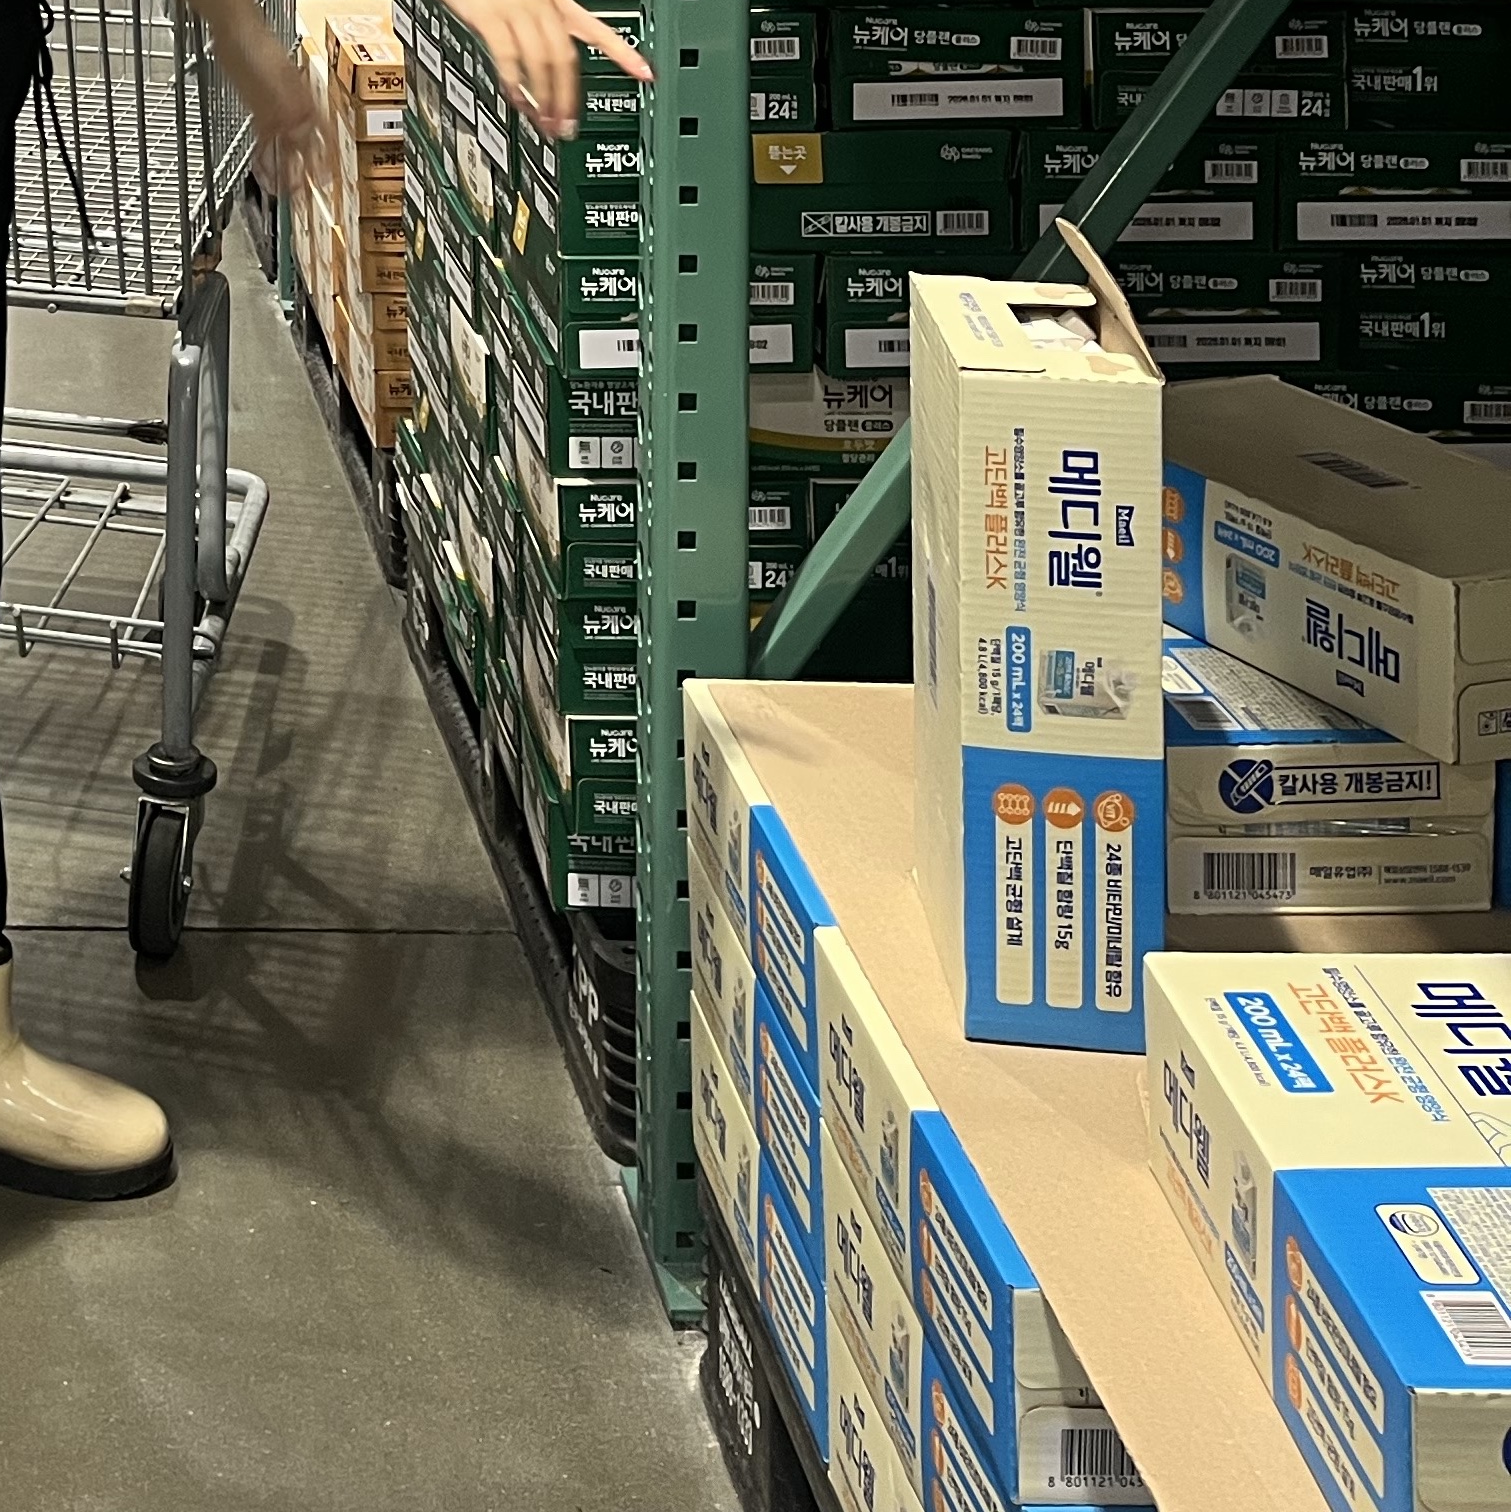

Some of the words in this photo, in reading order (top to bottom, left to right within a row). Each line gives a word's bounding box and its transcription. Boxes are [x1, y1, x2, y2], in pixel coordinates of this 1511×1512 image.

[853, 25, 909, 47] 뉴케어
[1354, 18, 1409, 38] 뉴케어
[1114, 31, 1171, 50] 뉴케어
[368, 76, 404, 90] 뉴케어
[769, 101, 790, 119] 24
[1301, 99, 1323, 117] 24
[596, 144, 630, 152] Nucare
[585, 152, 641, 173] 뉴케어
[1299, 151, 1355, 172] 뉴케어
[591, 267, 625, 276] Nucare
[858, 268, 891, 277] Nucare
[1360, 263, 1416, 283] 뉴케어
[580, 276, 636, 297] 뉴케어
[846, 278, 903, 298] 뉴케어
[823, 385, 893, 409] 뉴케어
[985, 445, 1008, 509] 고단백
[589, 494, 623, 502] Nucare
[579, 502, 635, 522] 뉴케어
[1048, 449, 1103, 589] 메디웰
[985, 513, 1008, 590] 플러스K
[765, 571, 787, 588] 24
[1011, 632, 1026, 665] 200
[1305, 597, 1400, 684] 메디웰
[1011, 667, 1027, 691] mL
[601, 728, 634, 737] Nucare
[1279, 773, 1338, 796] 칼사용
[1344, 769, 1432, 794] 개봉금지!
[1005, 835, 1023, 881] 고단백
[1056, 840, 1074, 885] 단백질
[1105, 843, 1123, 877] 24종
[1005, 884, 1023, 914] 균형
[1056, 889, 1074, 919] 함량
[1193, 890, 1200, 900] 8
[1207, 890, 1247, 900] 801121
[1251, 889, 1291, 900] 045473
[1005, 916, 1023, 946] 설계
[1054, 923, 1073, 950] 15g
[1105, 970, 1123, 998] 함유
[1237, 996, 1278, 1031] 200
[1256, 1029, 1286, 1054] mL
[1287, 982, 1357, 1034] 고단백
[1325, 1036, 1405, 1104] 플러스K
[1280, 1057, 1318, 1089] 24팩
[1163, 1058, 1211, 1189] 메디웰
[1047, 1476, 1056, 1488] 8
[1065, 1476, 1114, 1488] 801121
